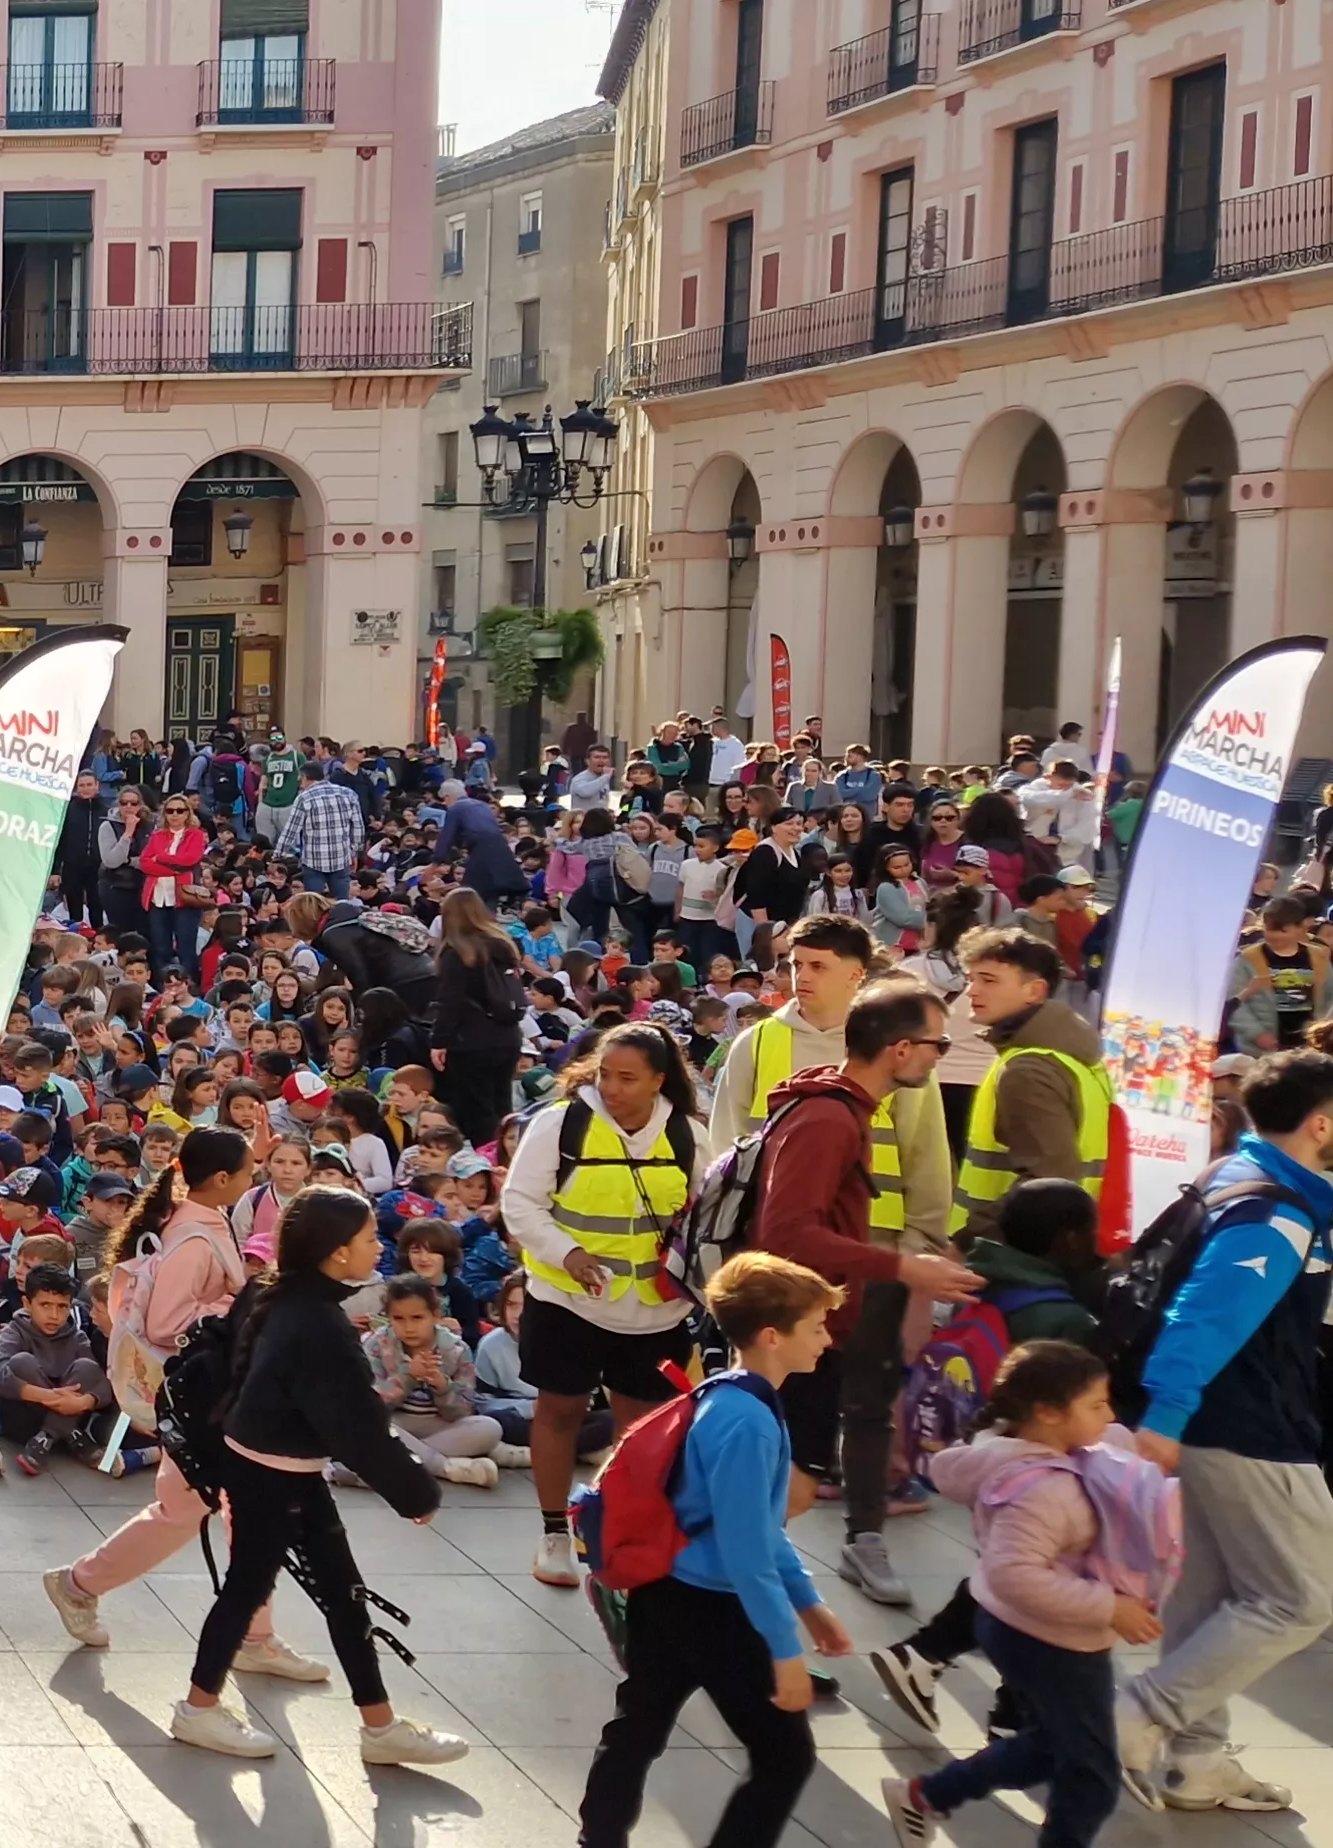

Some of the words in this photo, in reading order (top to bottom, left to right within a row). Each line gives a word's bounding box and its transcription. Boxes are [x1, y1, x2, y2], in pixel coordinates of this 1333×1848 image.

[22, 485, 33, 501] LA
[34, 485, 78, 501] CONFIANZA
[1204, 709, 1267, 738] MINI
[1184, 722, 1284, 782] MARCHA
[273, 773, 284, 789] 0
[1151, 789, 1264, 848] PIRINEOS
